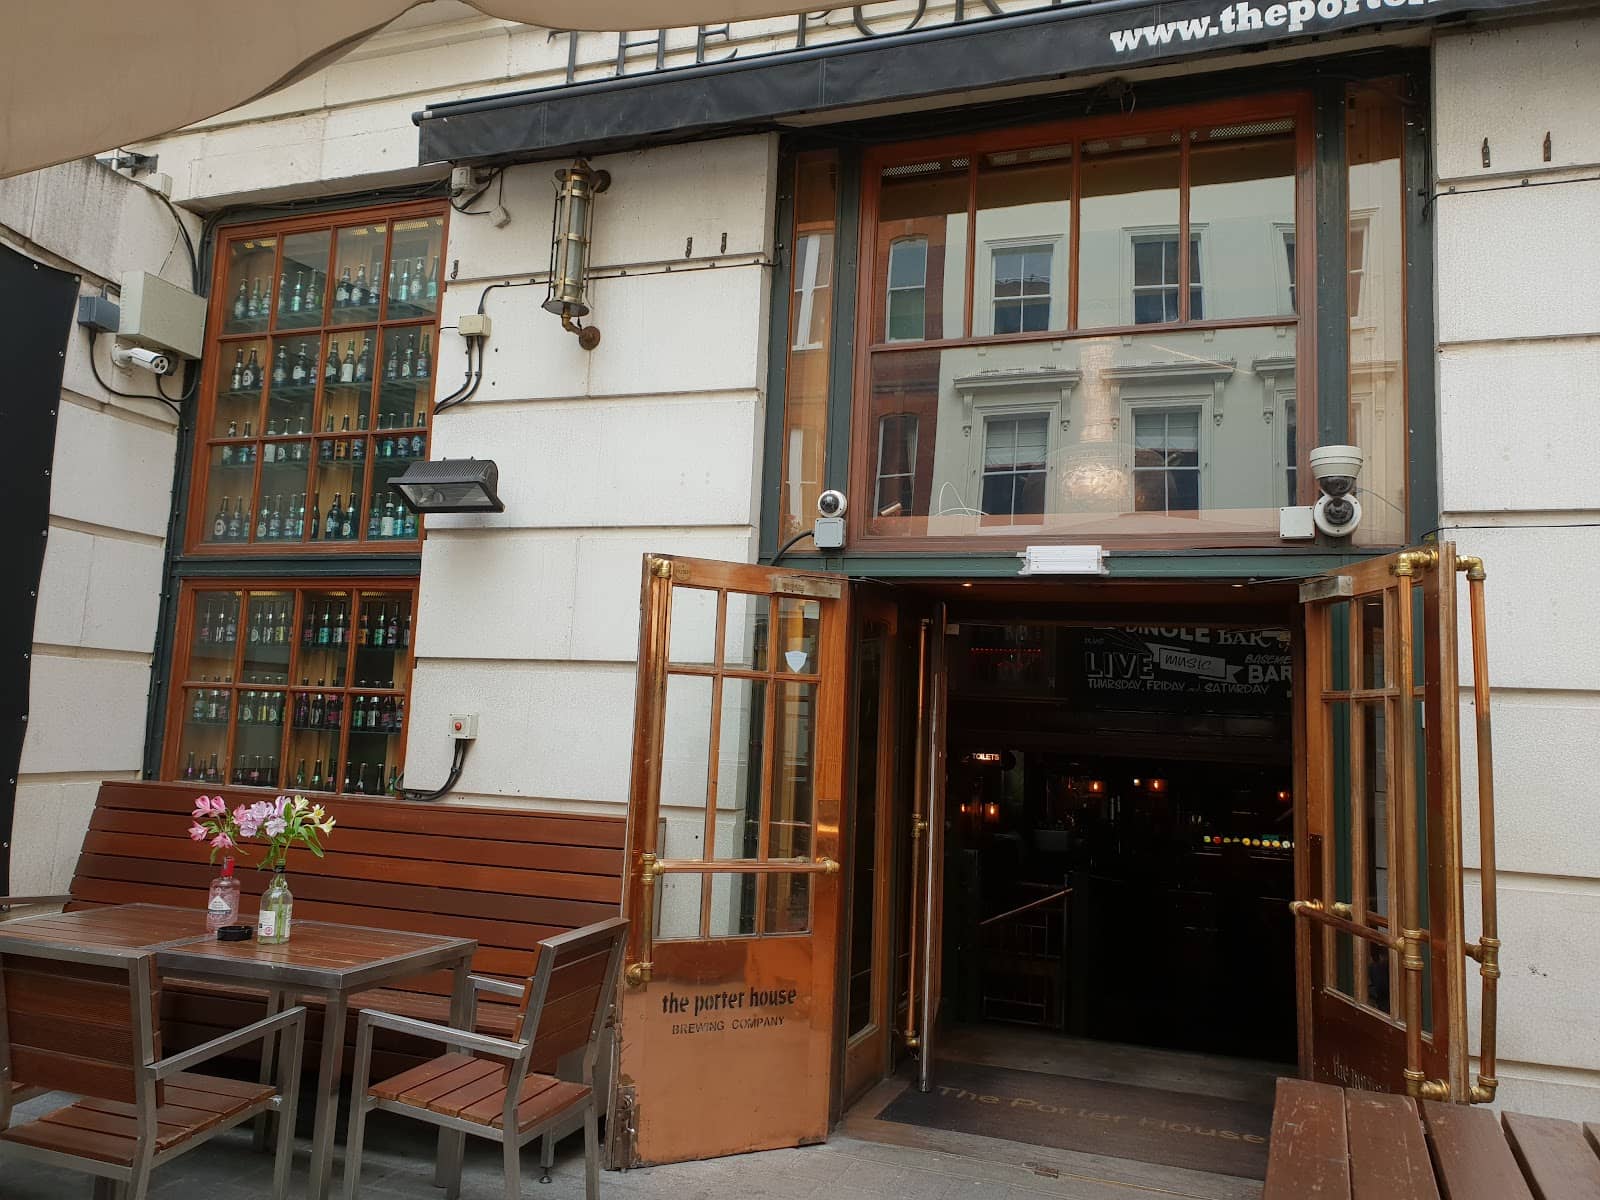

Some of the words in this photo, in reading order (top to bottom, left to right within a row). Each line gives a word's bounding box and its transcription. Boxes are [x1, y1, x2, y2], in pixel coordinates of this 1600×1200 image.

[1085, 650, 1155, 680] LIVE
[972, 752, 1000, 761] TOILETS
[662, 992, 689, 1014] the
[694, 991, 744, 1016] porter
[749, 986, 797, 1008] house
[672, 1020, 725, 1035] BREWING
[731, 1016, 785, 1031] COMPANY
[938, 1085, 1000, 1105] The
[1140, 1115, 1266, 1144] House
